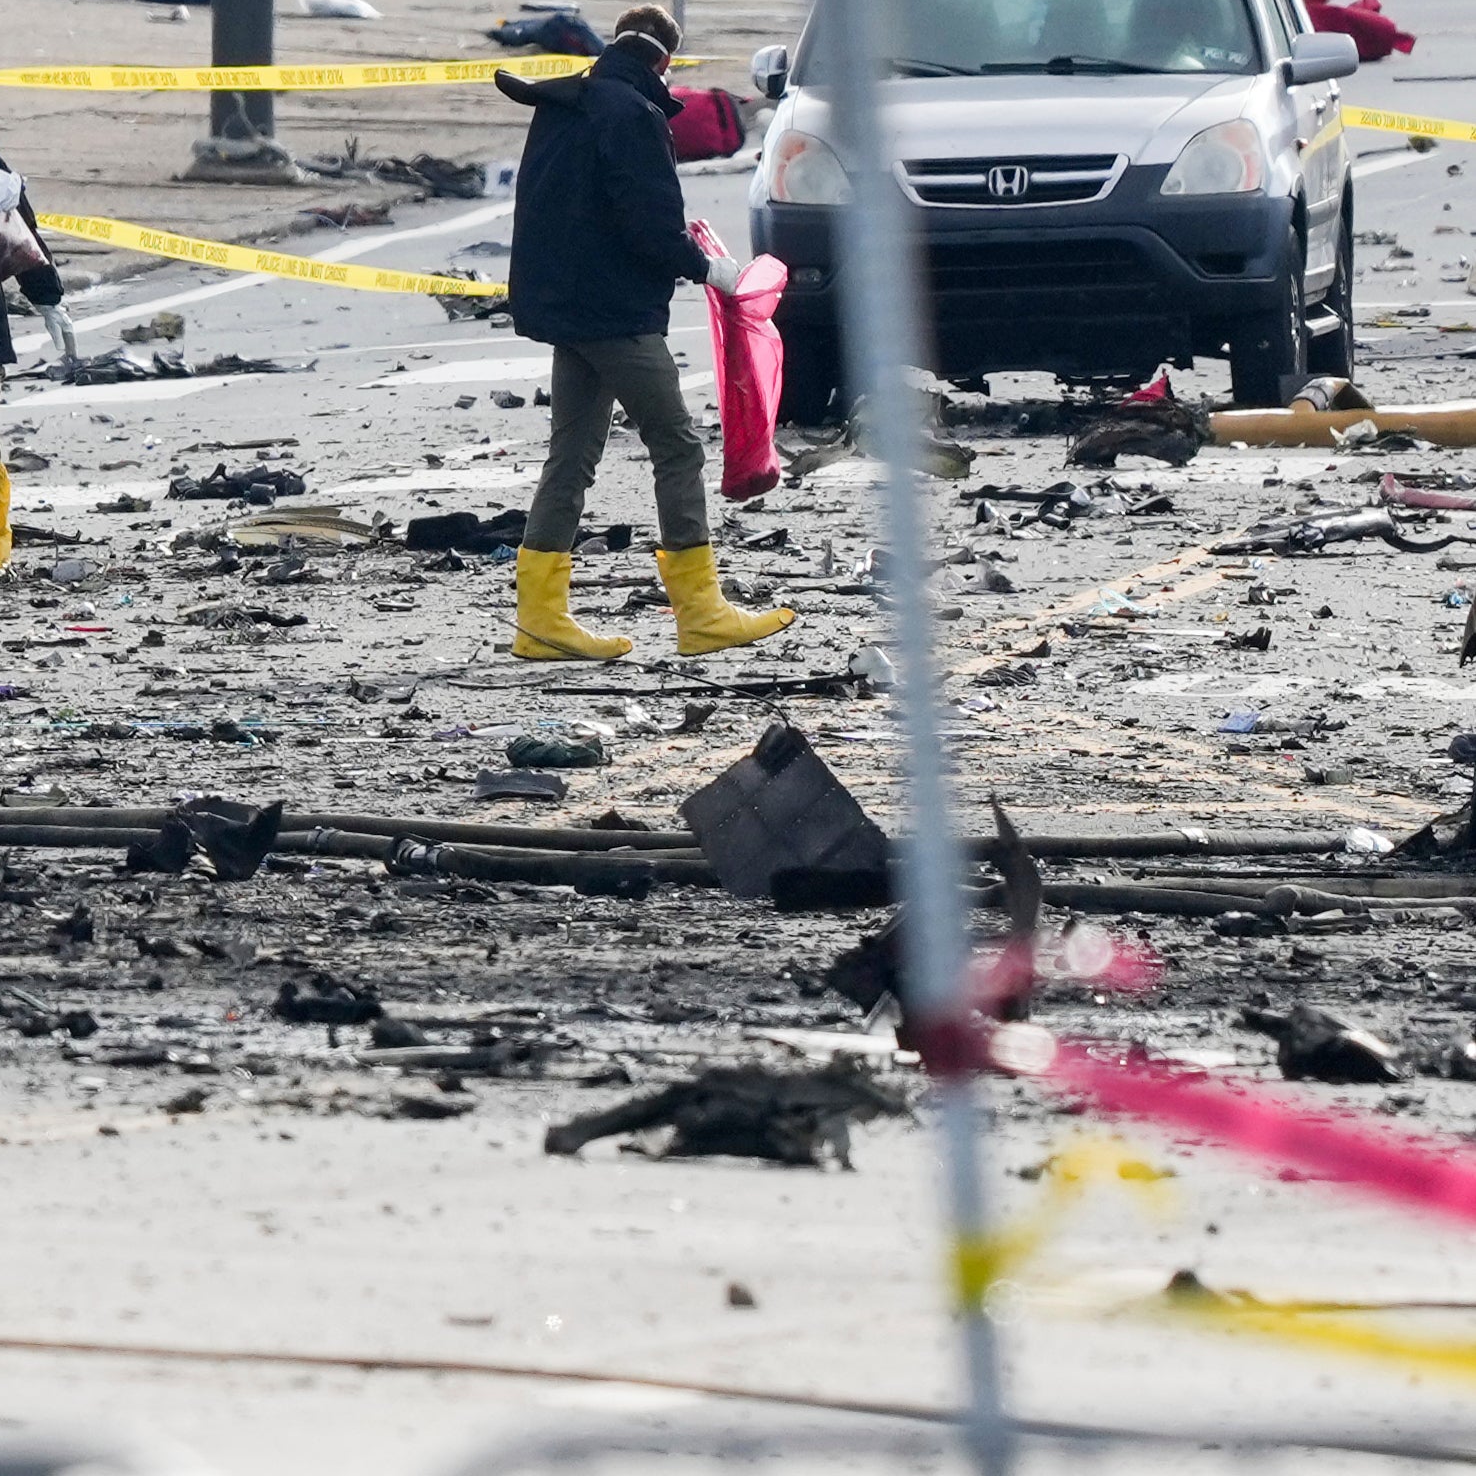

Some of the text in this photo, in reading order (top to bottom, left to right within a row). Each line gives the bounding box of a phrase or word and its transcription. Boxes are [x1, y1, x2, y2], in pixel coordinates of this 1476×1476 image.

[139, 231, 230, 264] POLICE LINE DO NOT CROSS
